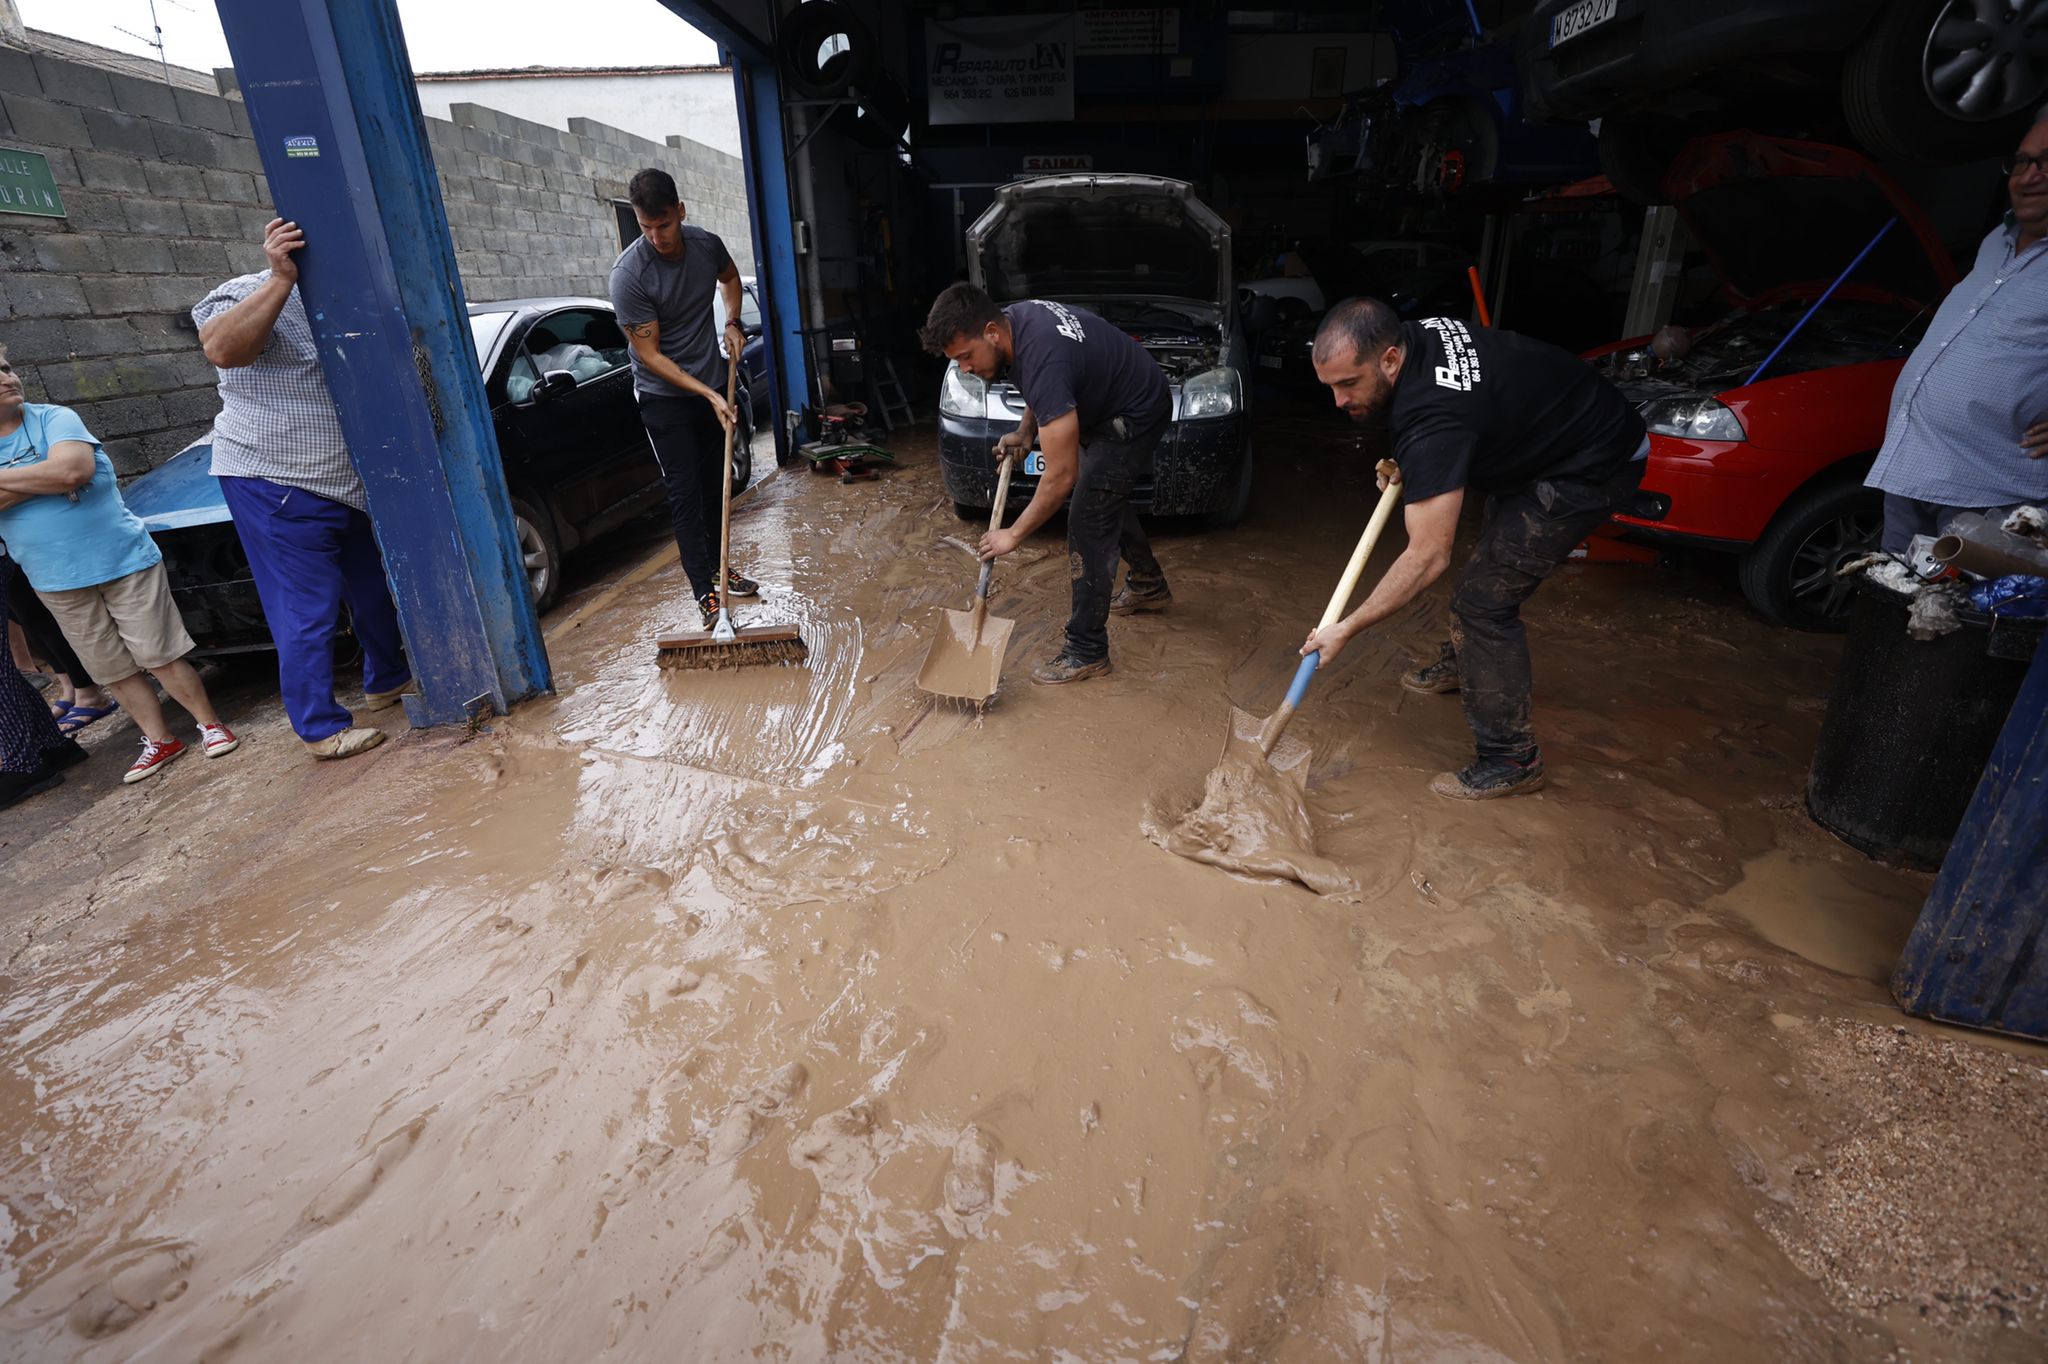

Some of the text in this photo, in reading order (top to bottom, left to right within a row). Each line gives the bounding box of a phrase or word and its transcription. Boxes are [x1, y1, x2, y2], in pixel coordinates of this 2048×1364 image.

[1564, 1, 1593, 37] 8732
[987, 73, 1016, 85] CHAPA
[1019, 73, 1025, 84] Y
[1027, 72, 1067, 84] PINTURA
[1028, 158, 1089, 170] SAIMA
[1434, 330, 1463, 391] REPARAUTO
